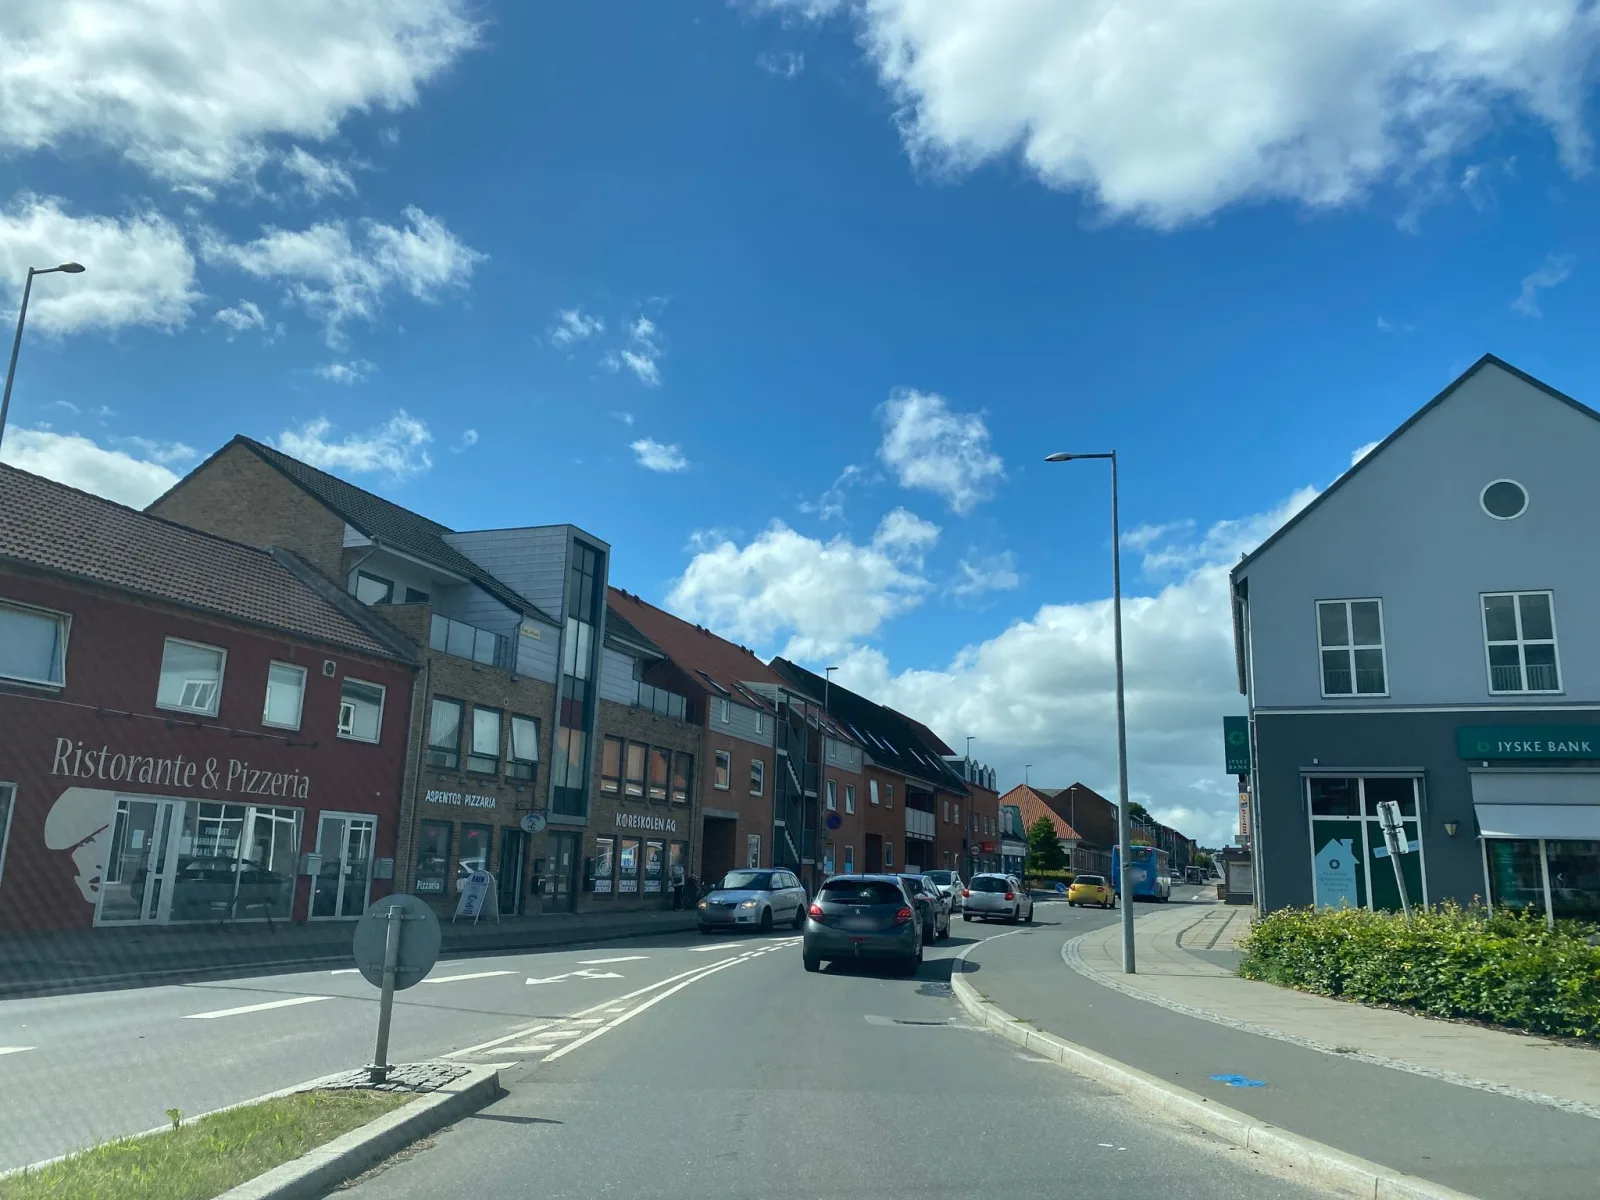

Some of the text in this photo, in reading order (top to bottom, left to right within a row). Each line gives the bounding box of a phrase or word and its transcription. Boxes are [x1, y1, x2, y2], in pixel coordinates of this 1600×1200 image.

[1498, 741, 1592, 753] JYSKE BANK
[50, 737, 310, 799] Ristorante & Pizzeria
[425, 789, 496, 809] ASPENTOS PIZZARIA
[665, 818, 676, 832] AG
